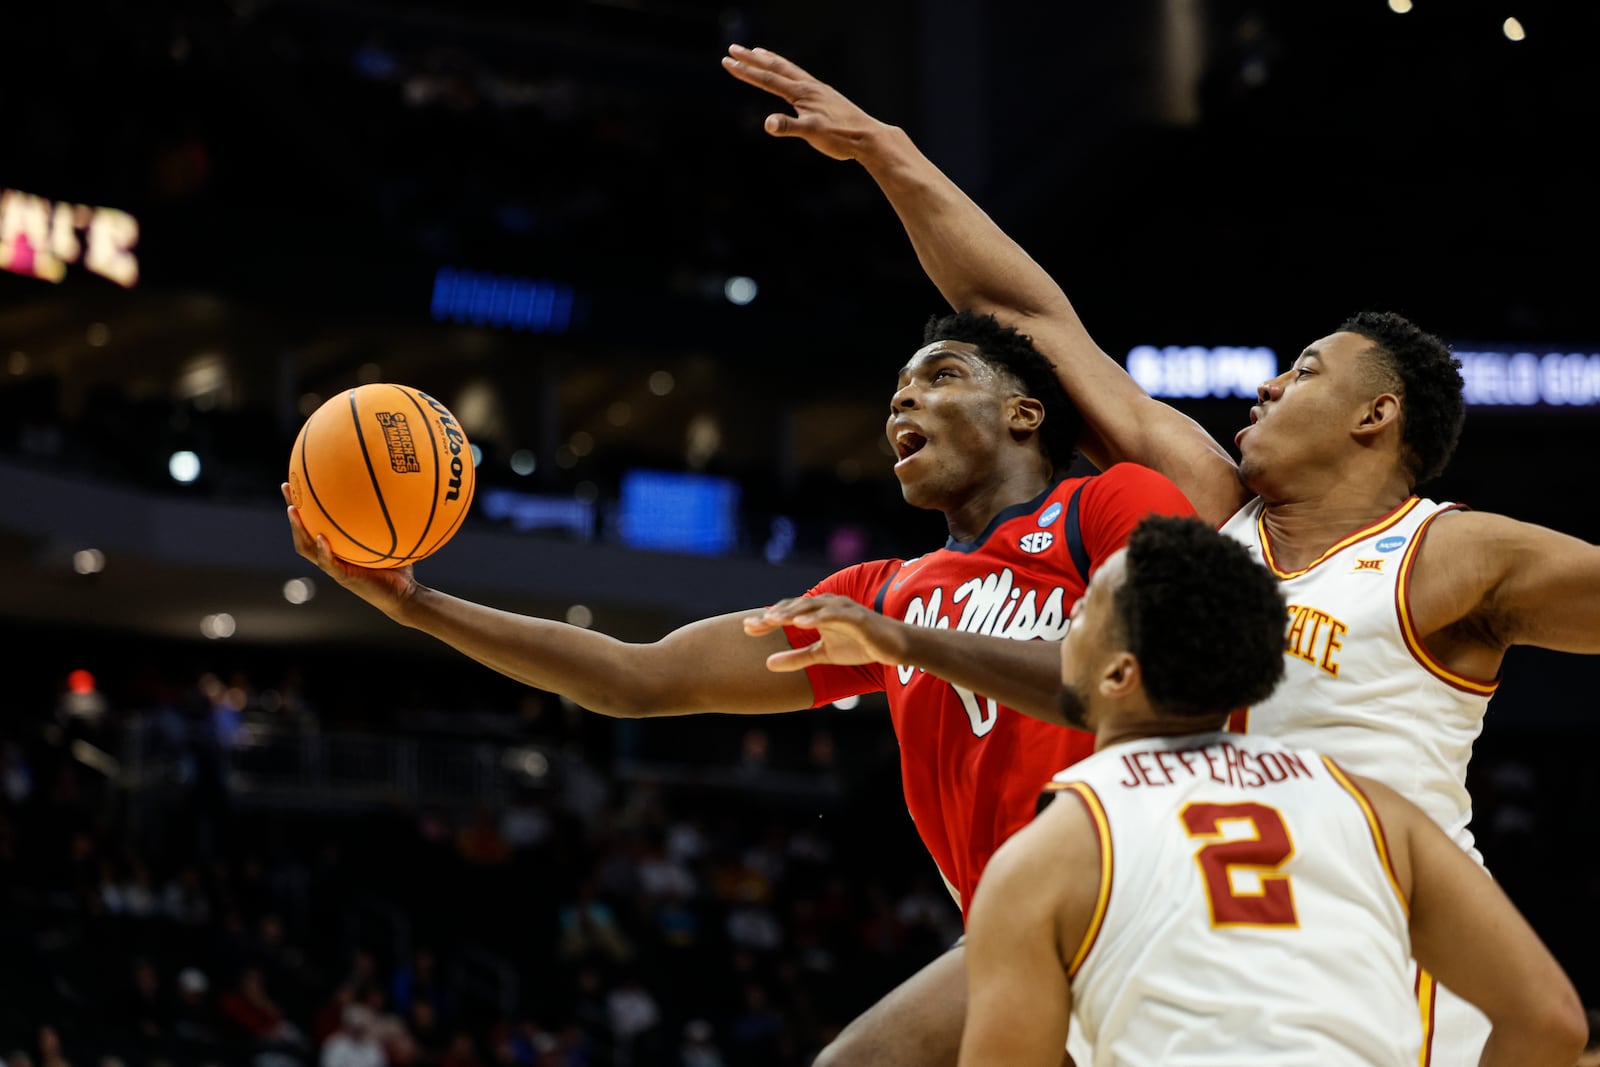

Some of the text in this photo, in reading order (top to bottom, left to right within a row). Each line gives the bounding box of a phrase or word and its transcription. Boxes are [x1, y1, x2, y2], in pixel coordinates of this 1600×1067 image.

[386, 426, 408, 473] MADNESS
[394, 420, 416, 455] MARCH
[1018, 531, 1054, 554] SEC
[953, 566, 1072, 642] Miss
[1285, 604, 1348, 678] ATE
[1120, 741, 1314, 789] JEFFERSON
[1177, 800, 1300, 930] 2
